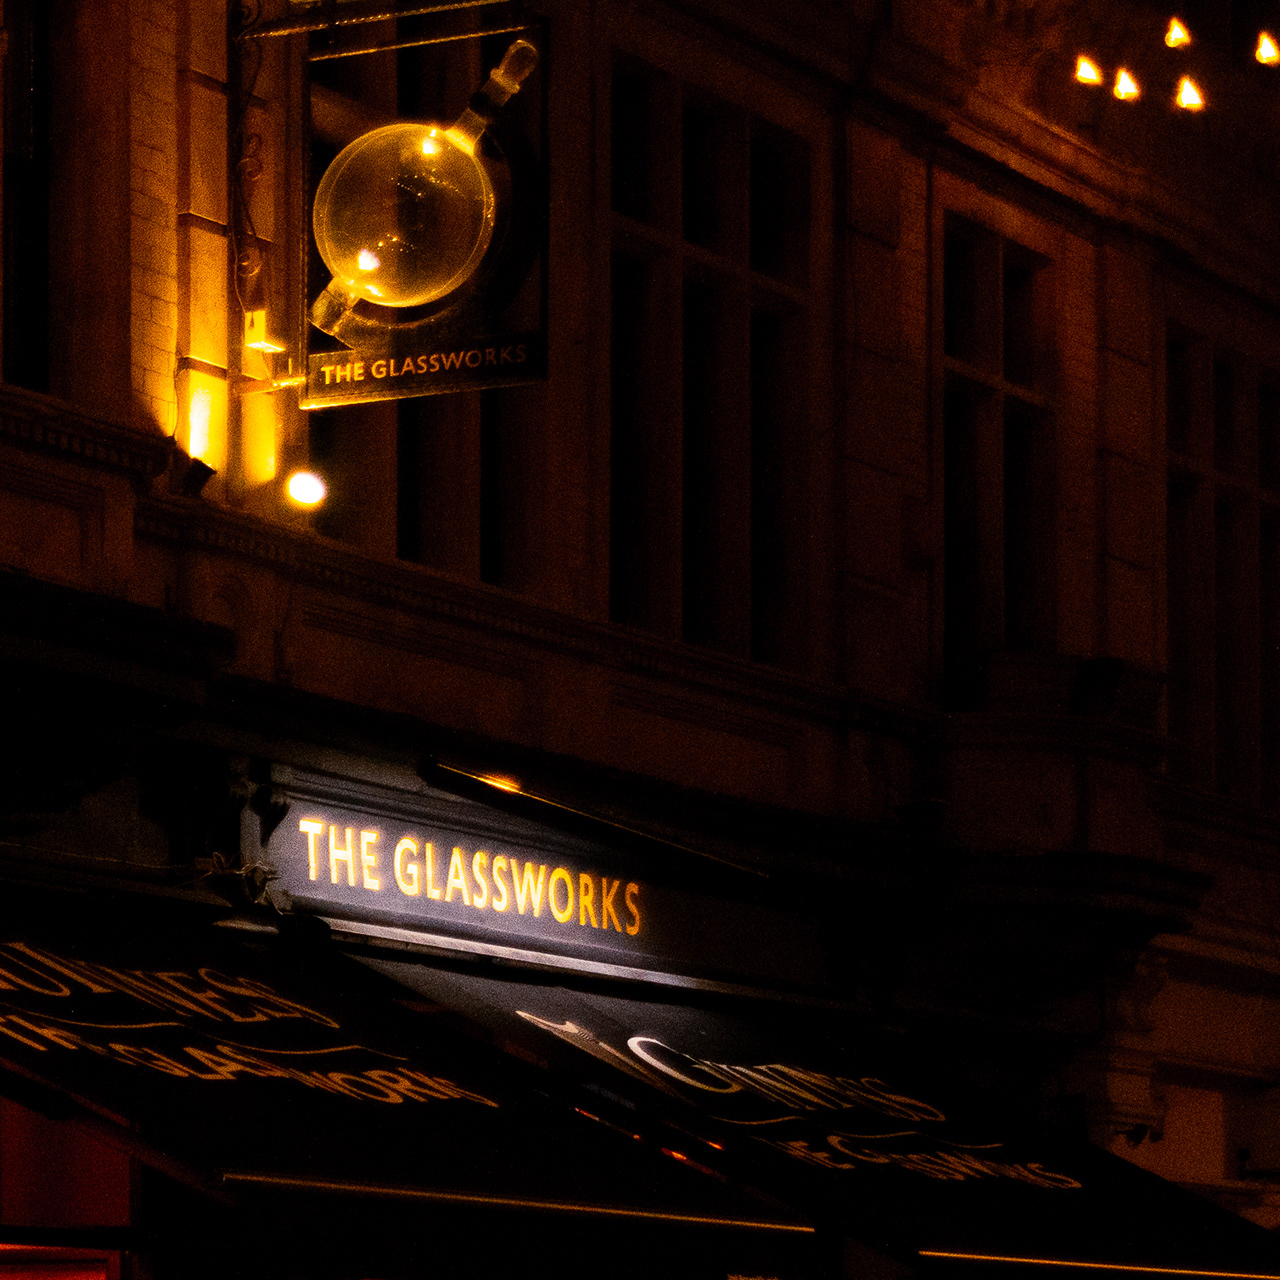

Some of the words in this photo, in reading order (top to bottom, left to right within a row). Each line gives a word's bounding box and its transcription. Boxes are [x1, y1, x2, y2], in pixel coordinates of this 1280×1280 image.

[321, 363, 365, 385] THE
[371, 344, 528, 379] GLASSWORKS
[298, 818, 381, 892] THE
[392, 836, 642, 937] GLASSWORKS
